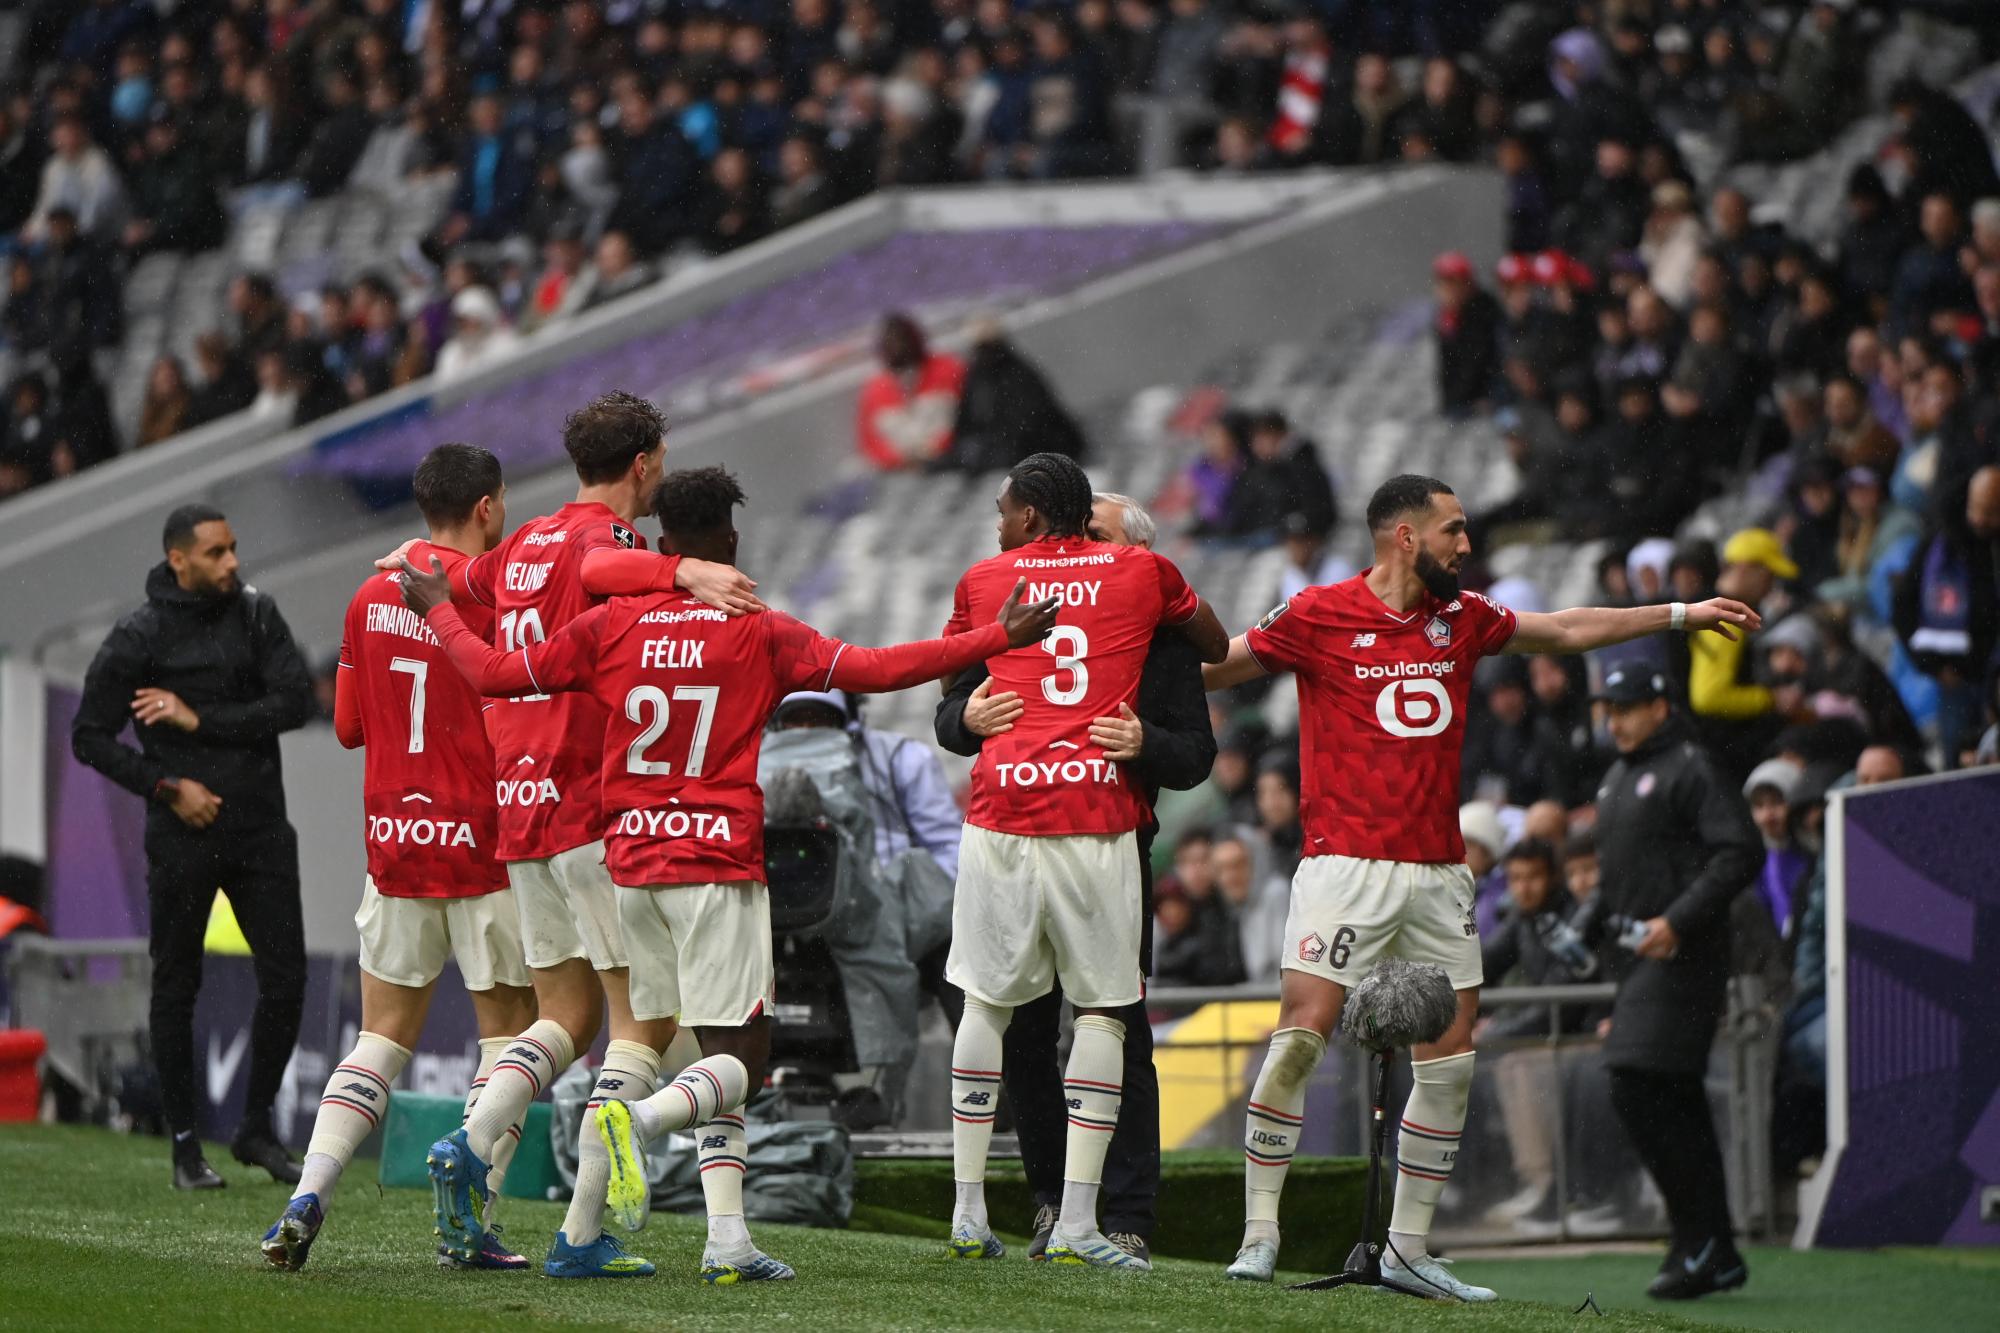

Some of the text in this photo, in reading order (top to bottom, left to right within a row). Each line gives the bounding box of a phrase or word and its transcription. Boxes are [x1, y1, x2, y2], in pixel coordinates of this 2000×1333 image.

[1014, 553, 1115, 568] AUSHOPPING
[1029, 580, 1102, 607] NGOY
[638, 609, 728, 624] AUSHOPPING
[641, 635, 706, 669] FÉLIX
[1041, 625, 1089, 706] 3
[1355, 660, 1456, 679] boulanger
[389, 656, 428, 754] 7
[625, 685, 720, 778] 27
[996, 759, 1119, 788] TOYOTA
[497, 778, 561, 807] OYOTA
[369, 815, 477, 848] TOYOTA
[616, 808, 731, 842] TOYOTA
[1329, 926, 1356, 970] 6
[1253, 1129, 1288, 1146] LOSC
